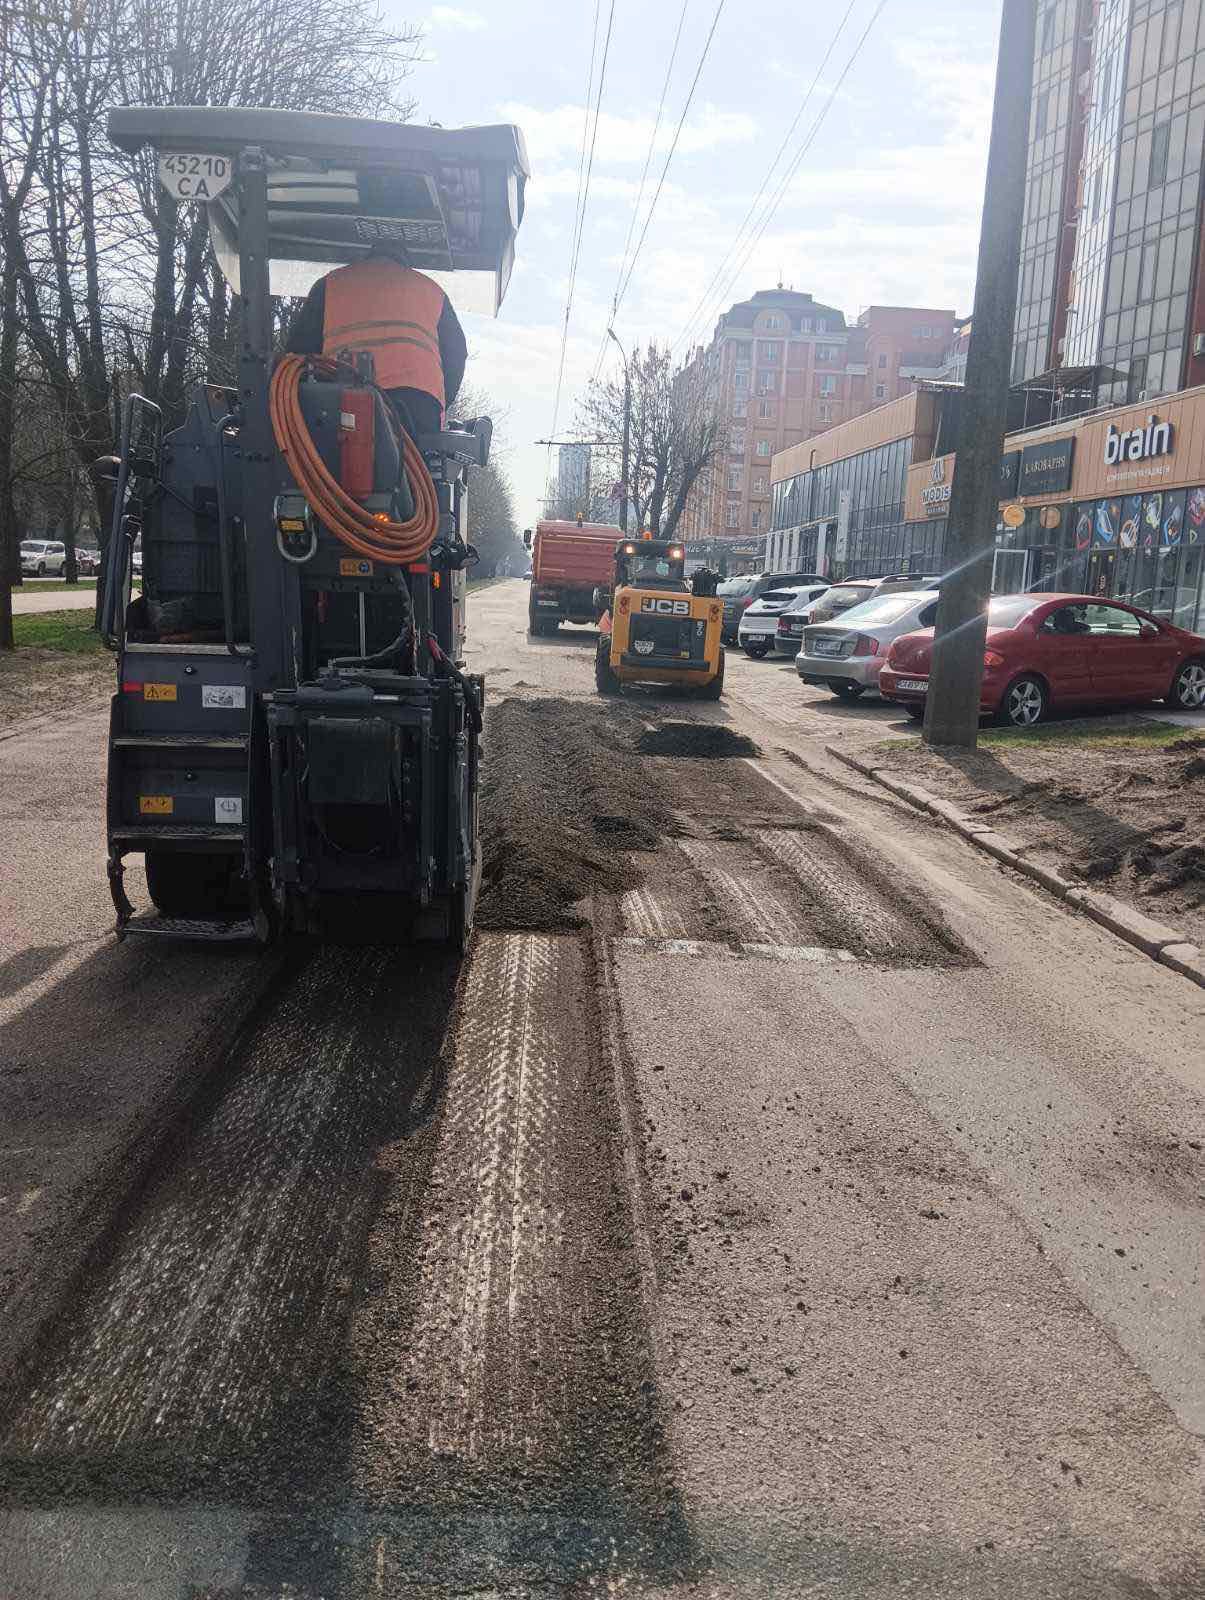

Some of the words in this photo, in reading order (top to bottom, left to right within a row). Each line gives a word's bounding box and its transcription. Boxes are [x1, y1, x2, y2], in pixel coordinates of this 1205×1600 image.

[164, 156, 226, 177] 45210
[1103, 415, 1174, 466] brain
[642, 599, 689, 615] JCB
